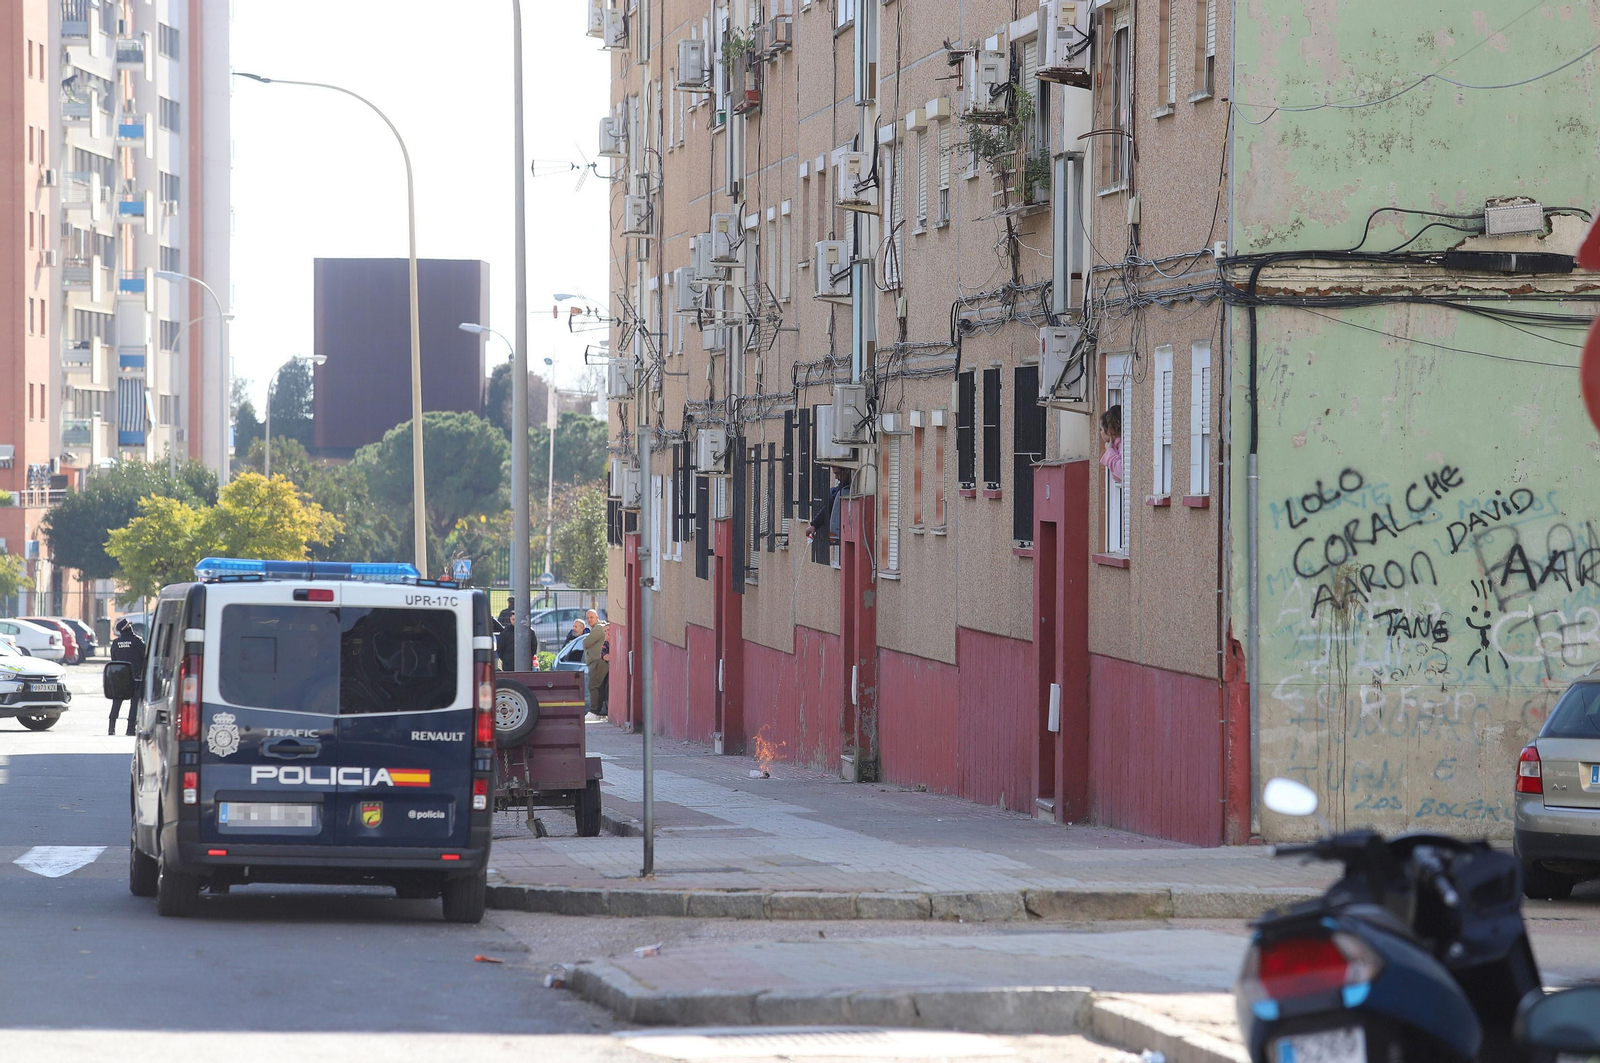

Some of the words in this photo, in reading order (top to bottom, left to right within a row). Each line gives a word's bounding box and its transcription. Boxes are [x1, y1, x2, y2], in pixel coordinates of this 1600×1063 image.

[1284, 467, 1364, 529] LOLO
[405, 594, 459, 607] UPR-17C
[263, 727, 320, 738] TRAFIC
[411, 730, 466, 742] RENAULT
[407, 809, 446, 821] @policia
